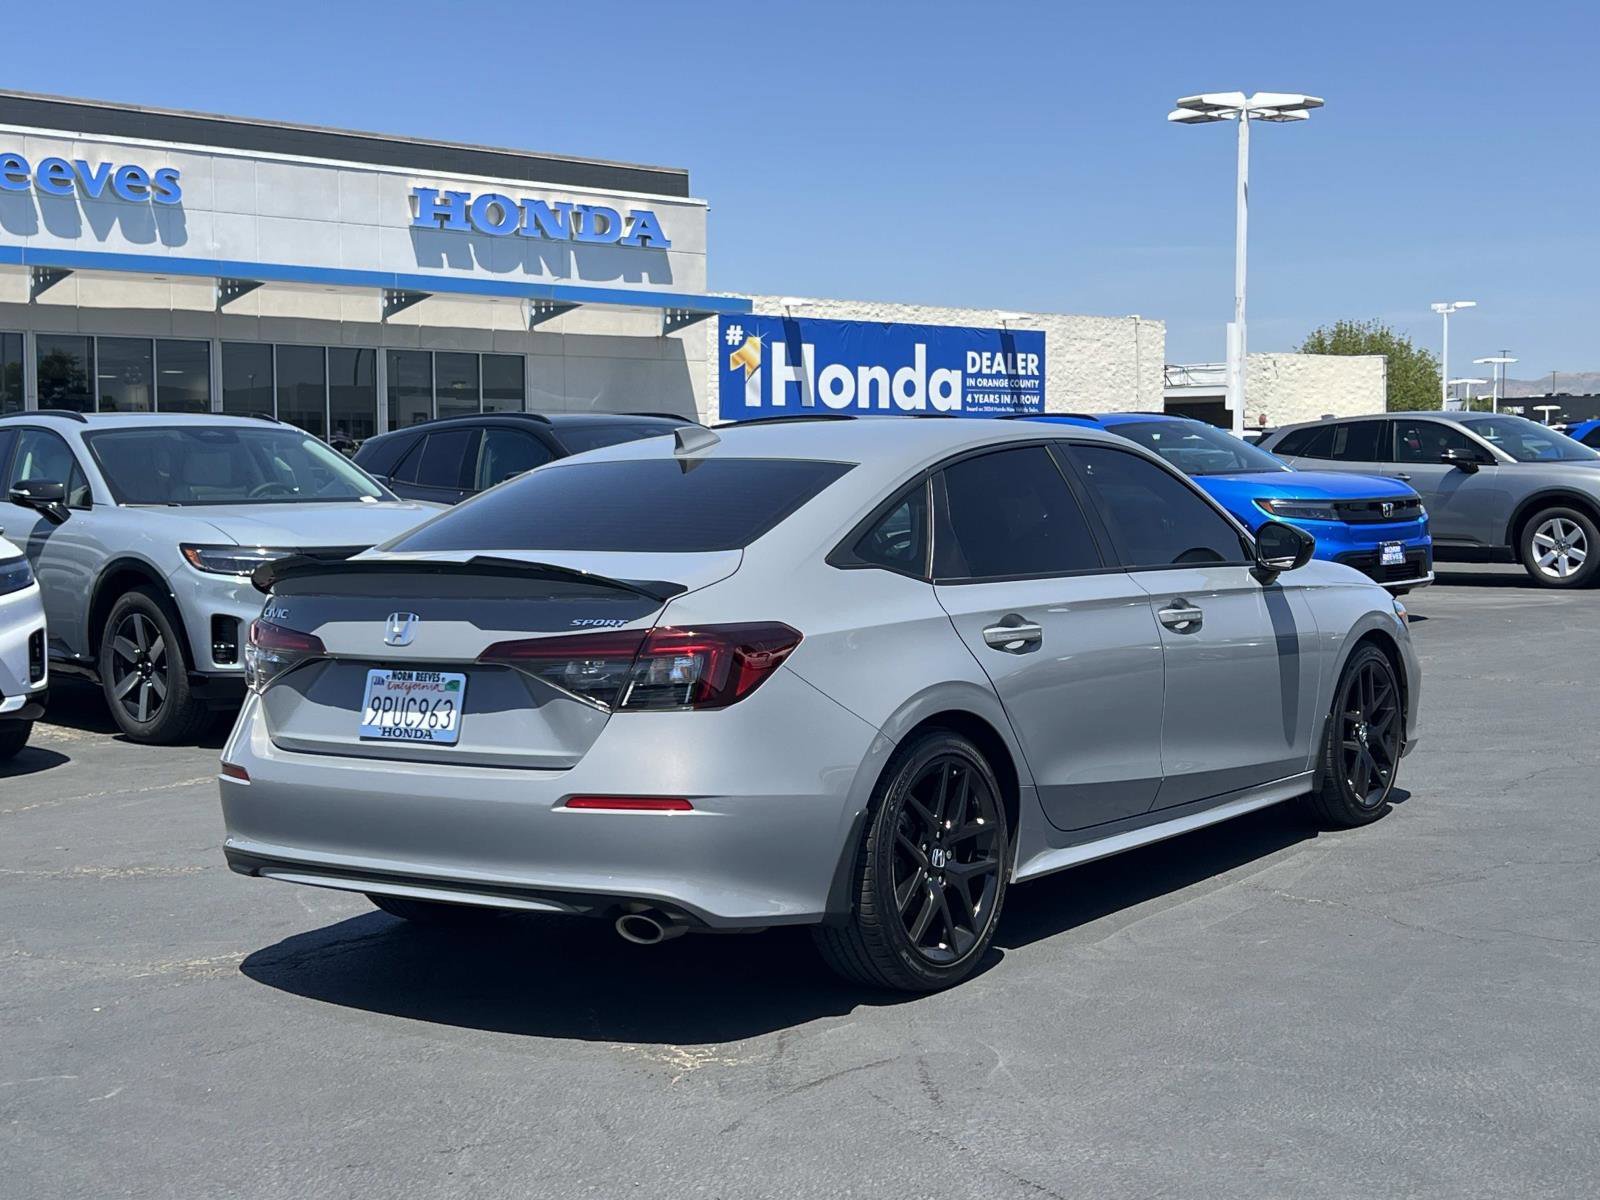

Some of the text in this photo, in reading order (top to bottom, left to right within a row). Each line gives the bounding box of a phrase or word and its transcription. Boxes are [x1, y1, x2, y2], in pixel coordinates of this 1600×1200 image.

[0, 152, 182, 204] eeves
[411, 187, 671, 250] HONDA
[966, 351, 1040, 376] DEALER
[771, 341, 962, 412] Honda
[966, 377, 1039, 389] IN ORANGE COUNTY
[966, 393, 1040, 405] 4 YEARS IN A ROW
[263, 607, 289, 619] CIVIC
[570, 619, 629, 629] SPORT
[391, 671, 441, 682] NORM REEVES
[387, 682, 445, 695] California
[368, 696, 454, 729] 9PUC963
[380, 727, 434, 740] HONDA
